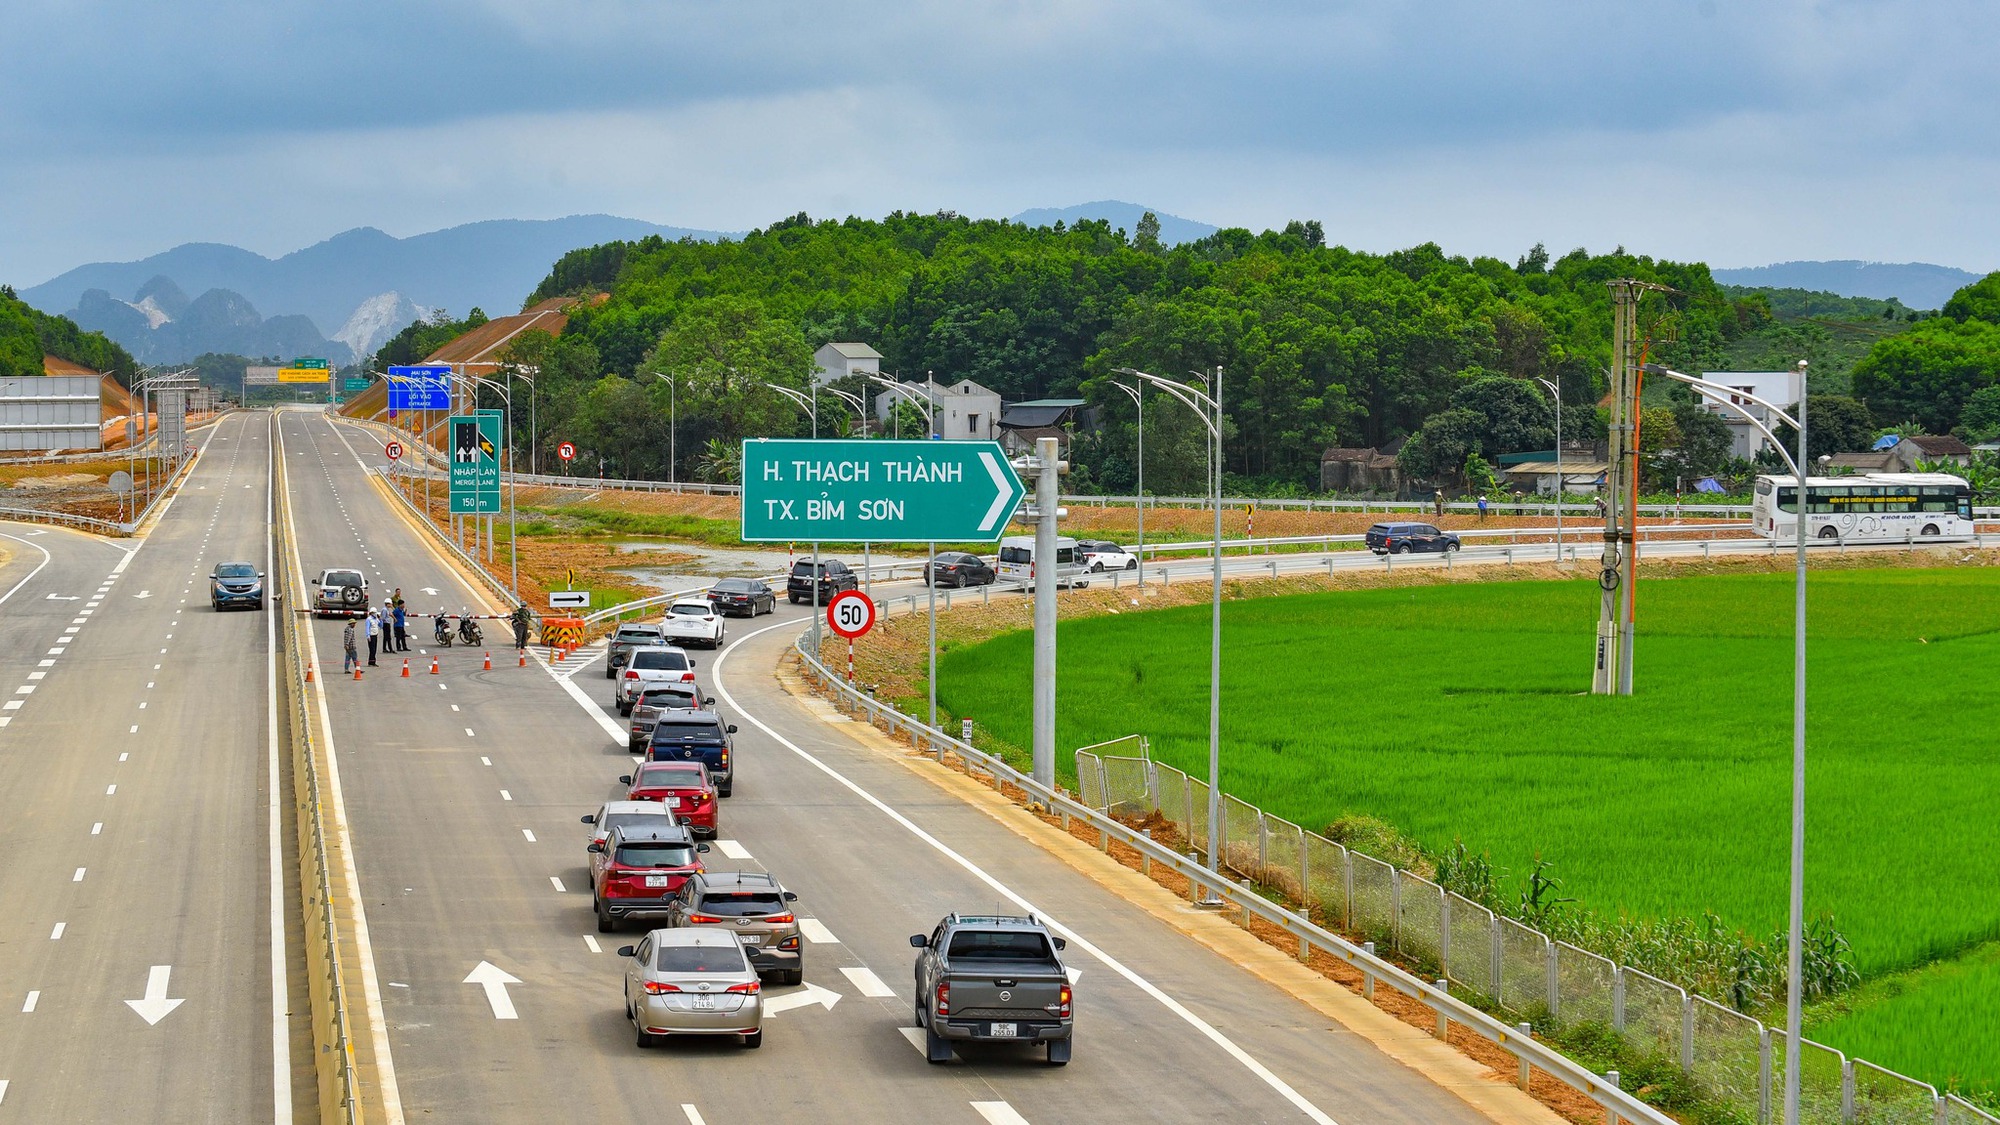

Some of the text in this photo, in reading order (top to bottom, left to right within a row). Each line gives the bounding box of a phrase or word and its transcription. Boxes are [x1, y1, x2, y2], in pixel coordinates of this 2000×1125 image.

[454, 466, 496, 478] NHẬP LÀN
[763, 455, 963, 486] H. THẠCH THÀNH
[462, 497, 475, 507] 150
[763, 491, 905, 520] TX. BỈM SƠN
[840, 605, 862, 625] 50
